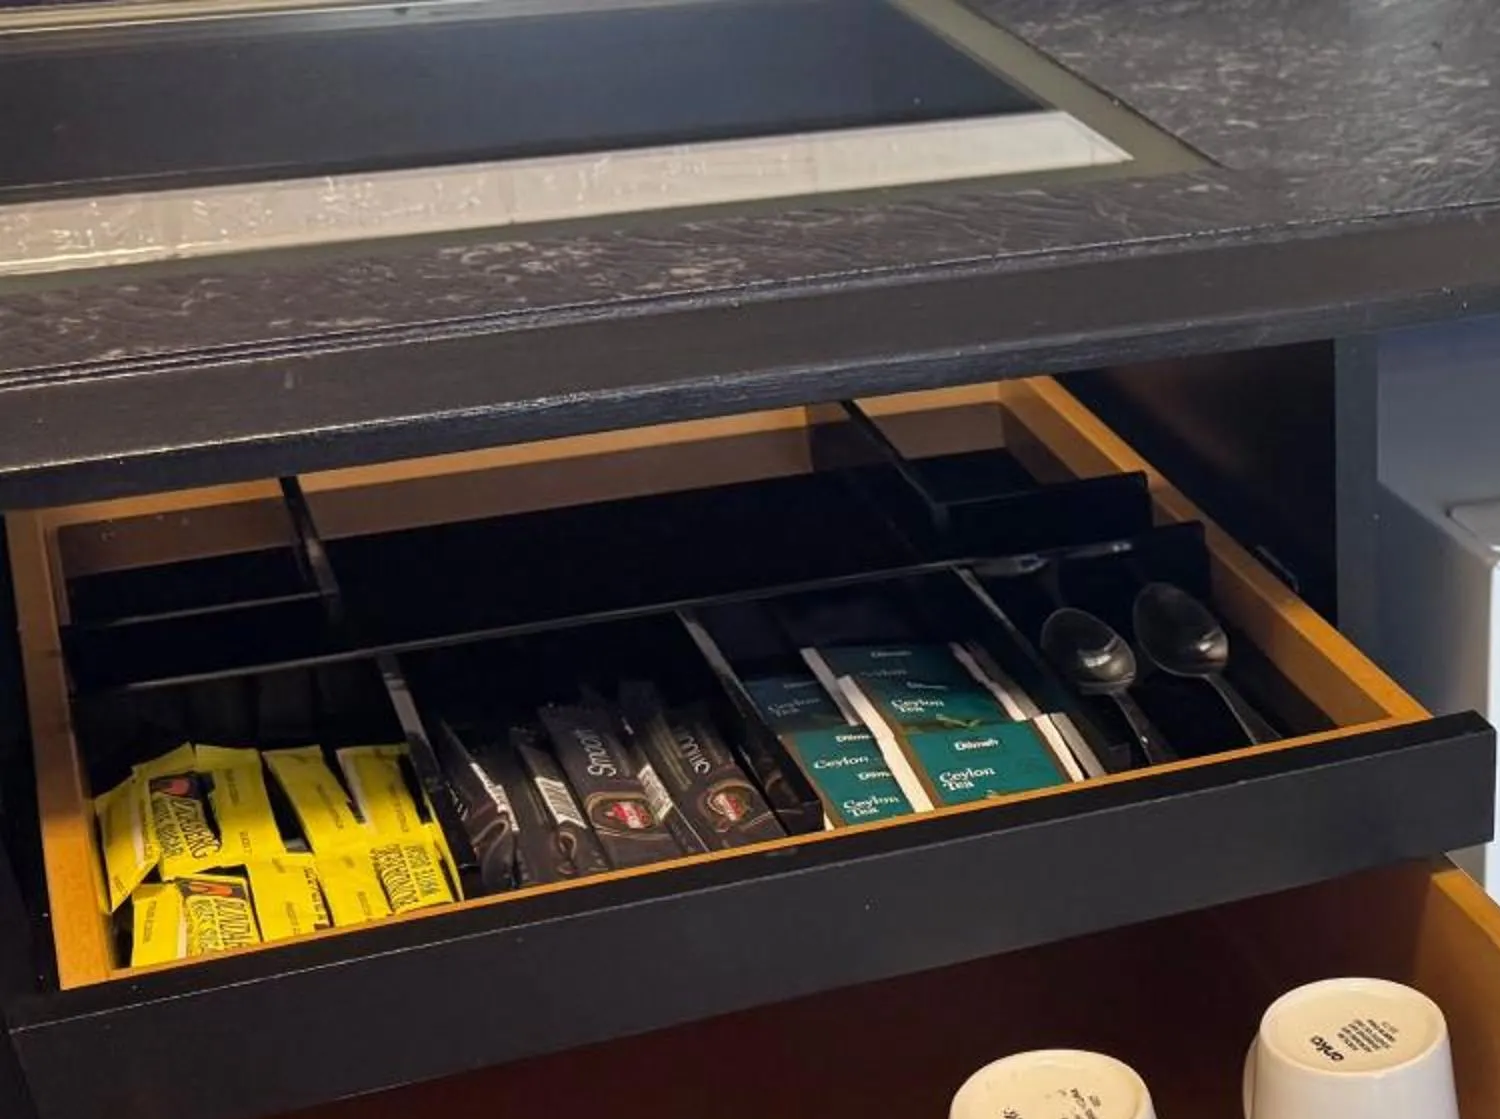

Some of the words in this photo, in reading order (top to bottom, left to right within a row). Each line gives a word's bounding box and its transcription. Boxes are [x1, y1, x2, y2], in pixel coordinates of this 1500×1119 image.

[939, 767, 996, 783] Ceylon
[943, 780, 976, 791] Tea
[1310, 1035, 1345, 1061] anko
